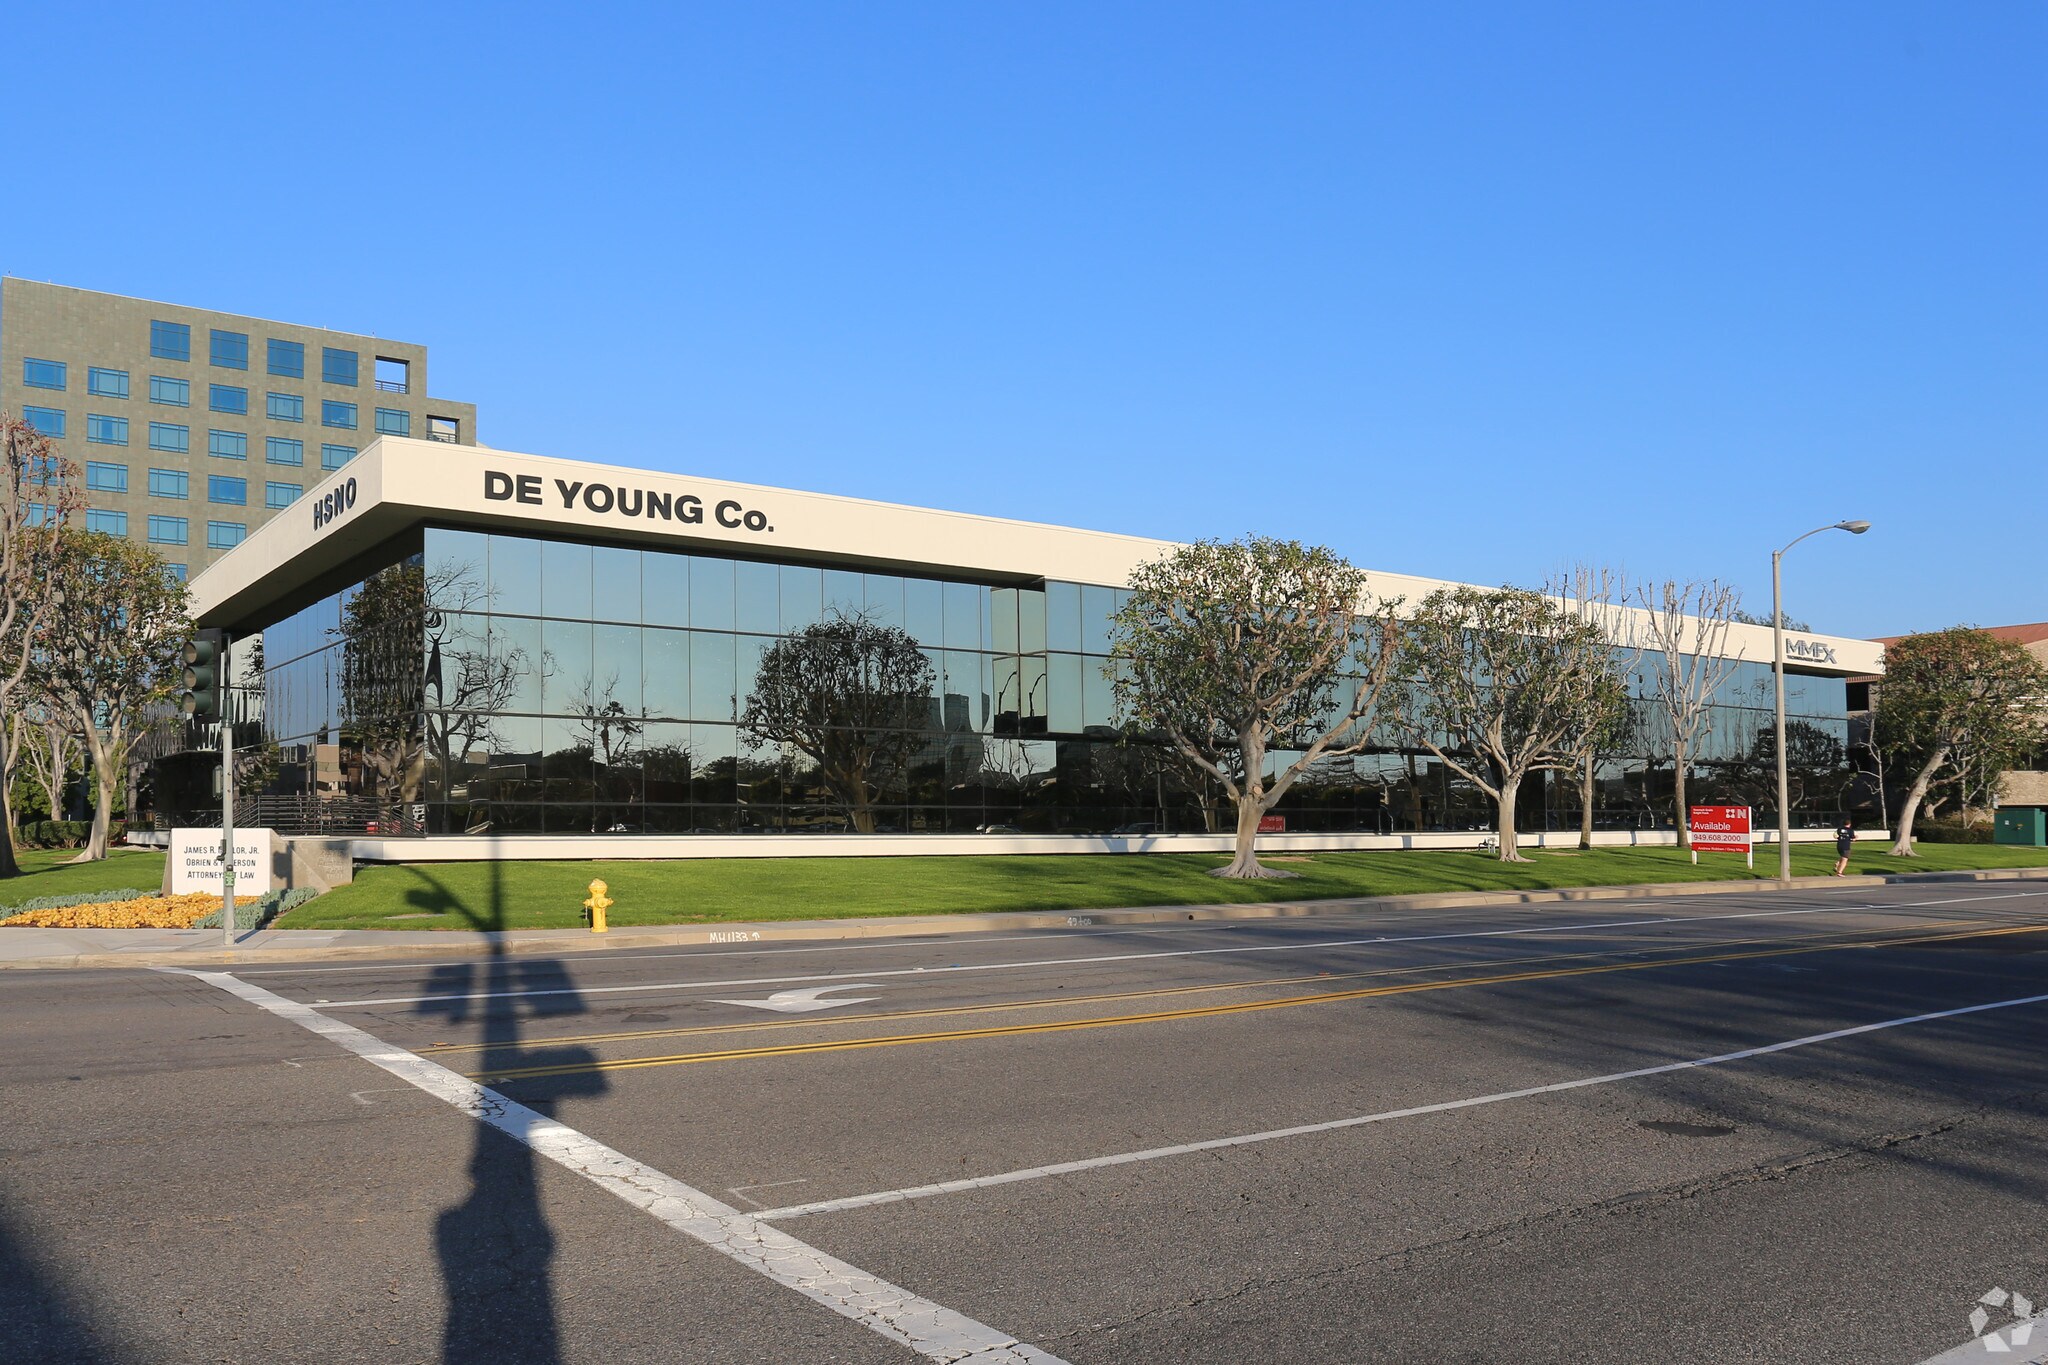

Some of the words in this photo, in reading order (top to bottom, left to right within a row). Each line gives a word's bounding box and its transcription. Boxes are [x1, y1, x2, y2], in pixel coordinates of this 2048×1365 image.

[313, 476, 357, 531] HSNO
[484, 470, 543, 505] DE
[554, 478, 703, 524] YOUNG
[714, 500, 775, 532] Co.
[1785, 638, 1838, 664] MMFX
[1693, 822, 1731, 831] Available
[1693, 833, 1741, 842] 949.608.2000
[184, 846, 208, 854] JAMES
[209, 846, 216, 854] R.
[248, 846, 260, 855] JR.
[186, 858, 211, 867] OBRIEN
[213, 859, 218, 867] &
[240, 871, 255, 879] LAW
